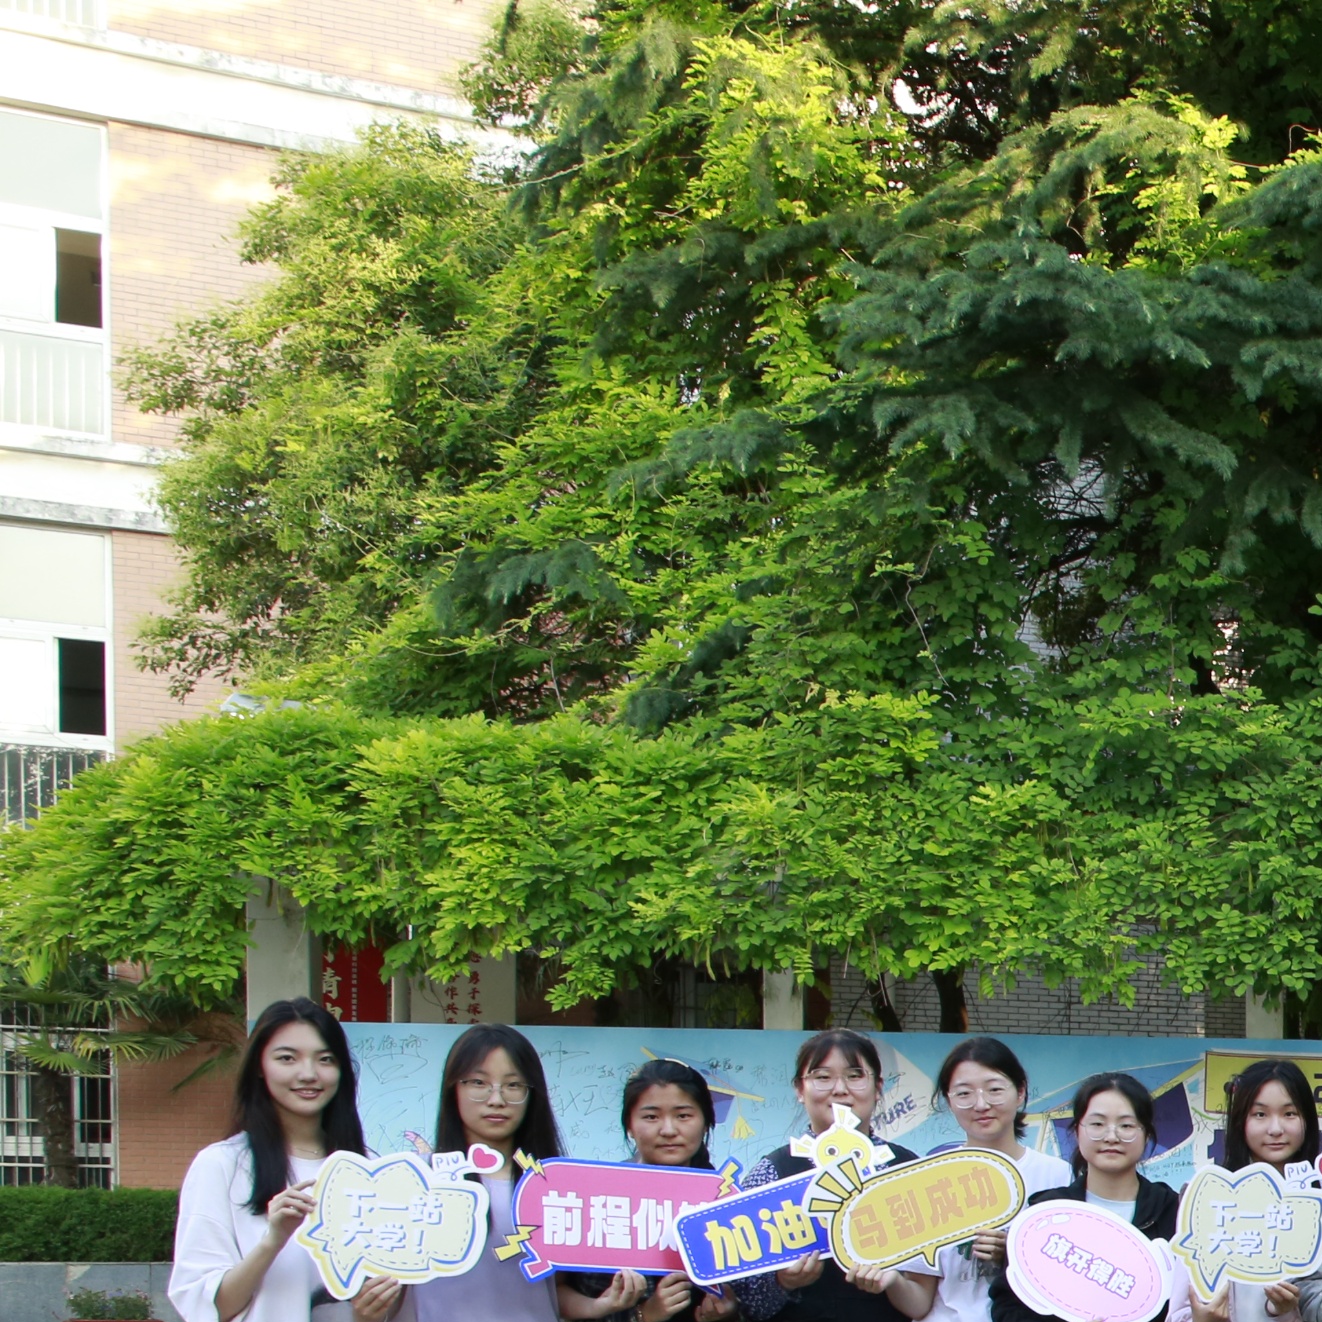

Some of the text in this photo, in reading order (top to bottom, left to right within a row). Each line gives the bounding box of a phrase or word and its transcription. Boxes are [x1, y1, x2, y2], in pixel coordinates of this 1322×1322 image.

[343, 1188, 443, 1226] 下一站
[542, 1190, 711, 1252] 前程似
[704, 1199, 828, 1270] 加油
[850, 1166, 999, 1249] 马到成功
[1209, 1201, 1295, 1232] 下一站
[1040, 1233, 1136, 1300] 旗开得胜
